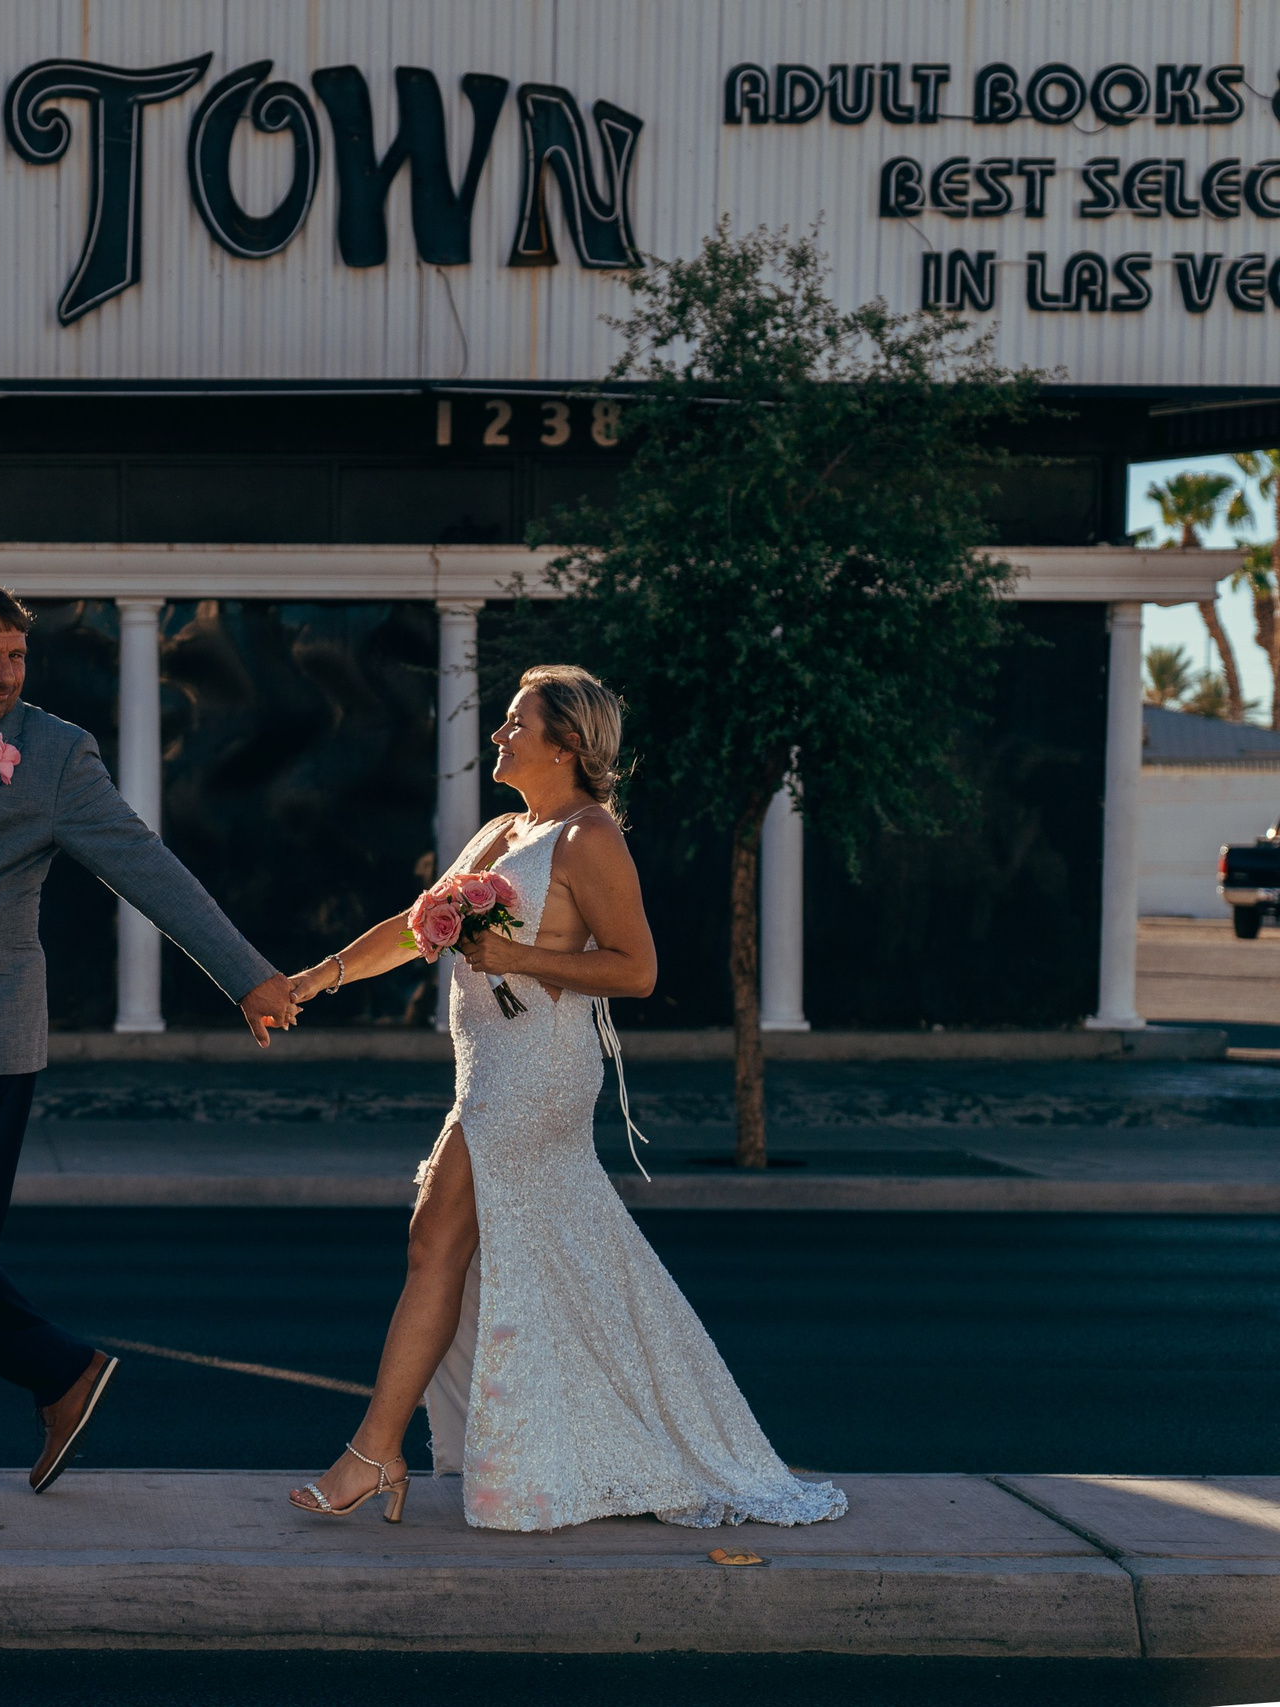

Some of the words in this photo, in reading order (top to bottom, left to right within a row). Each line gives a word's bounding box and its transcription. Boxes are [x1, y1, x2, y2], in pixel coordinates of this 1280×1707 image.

[724, 62, 951, 125] ADULT
[973, 62, 1245, 125] BOOKS
[4, 51, 646, 327] TOWN
[879, 155, 1056, 219] BEST
[1079, 156, 1280, 219] SELEC
[921, 249, 997, 312] IN
[1026, 249, 1152, 313] LAS
[1172, 252, 1280, 313] VE
[436, 399, 622, 447] 1238
